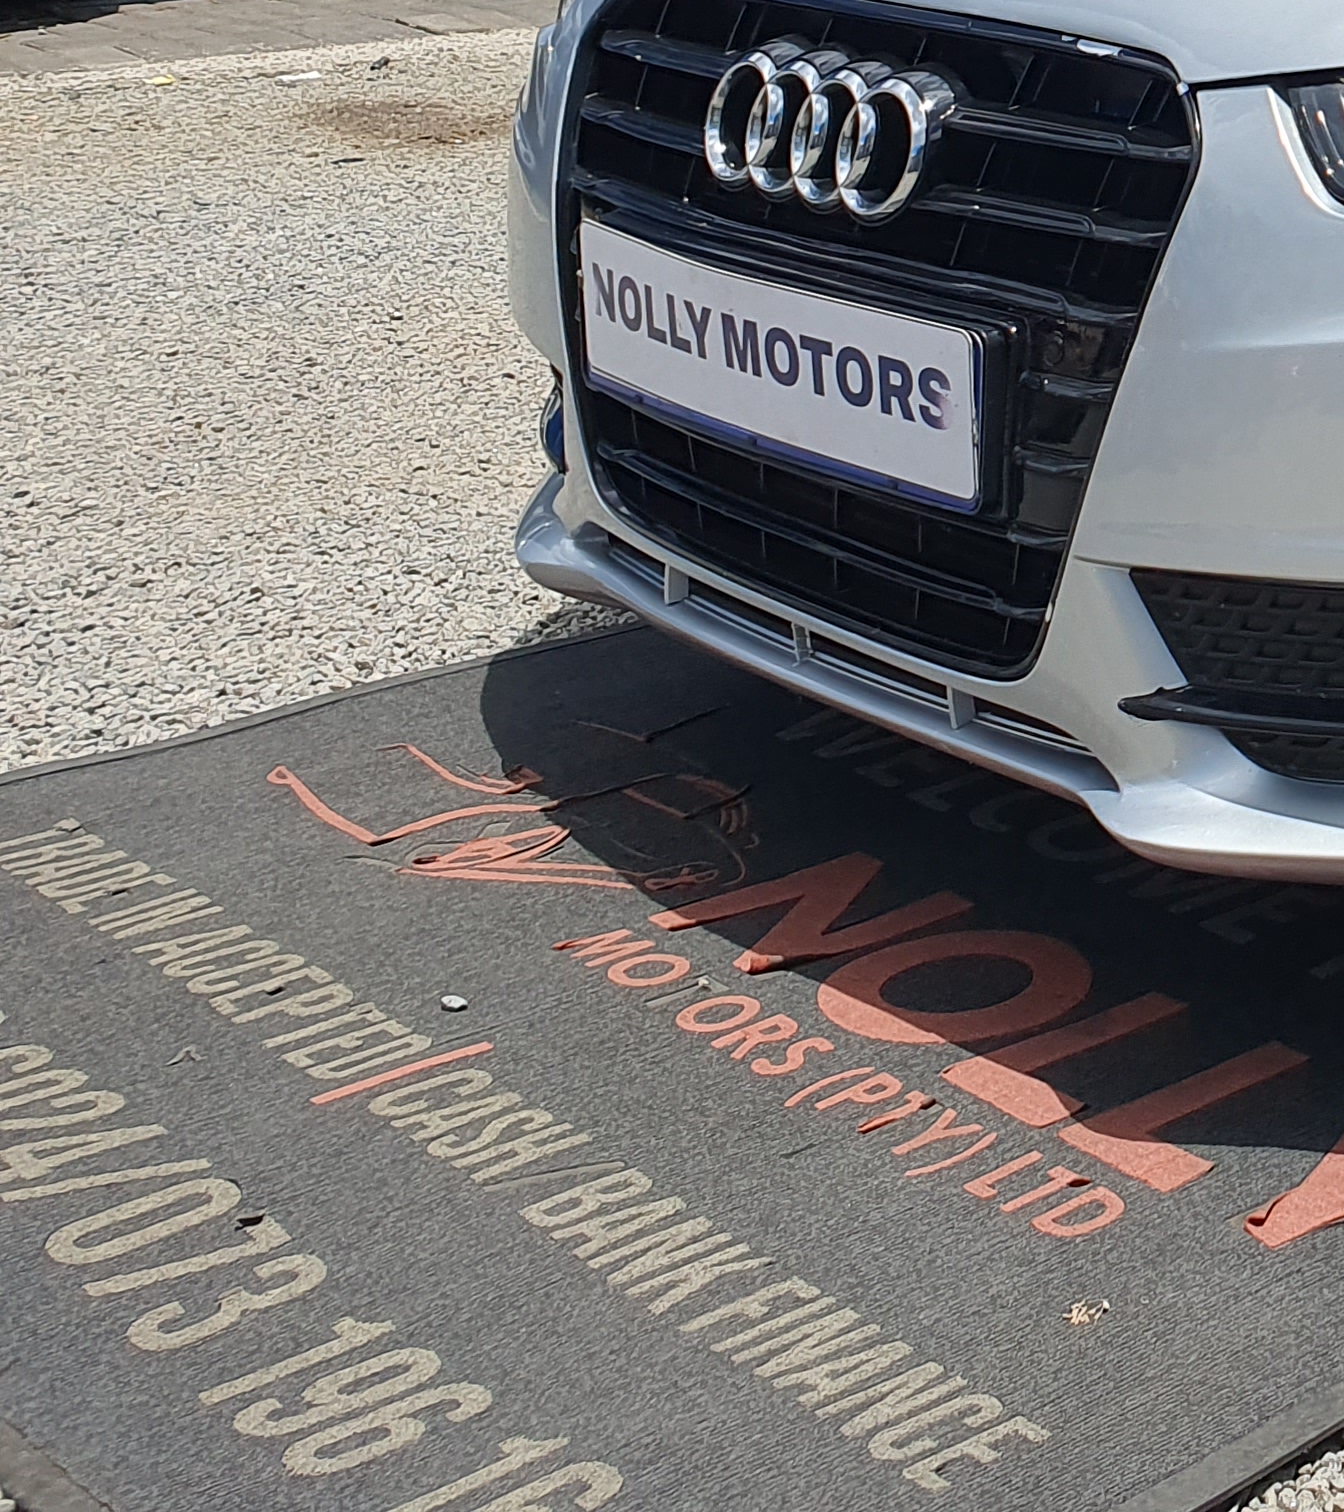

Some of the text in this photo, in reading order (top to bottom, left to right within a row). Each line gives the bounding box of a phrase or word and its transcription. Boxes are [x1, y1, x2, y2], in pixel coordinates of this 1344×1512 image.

[591, 261, 952, 431] NOLLY MOTORS
[87, 888, 225, 940] IN
[680, 1276, 1053, 1493] FINANCE
[783, 1066, 997, 1178] (PTY)
[963, 1150, 1126, 1238] LTD
[199, 1316, 493, 1477] 196
